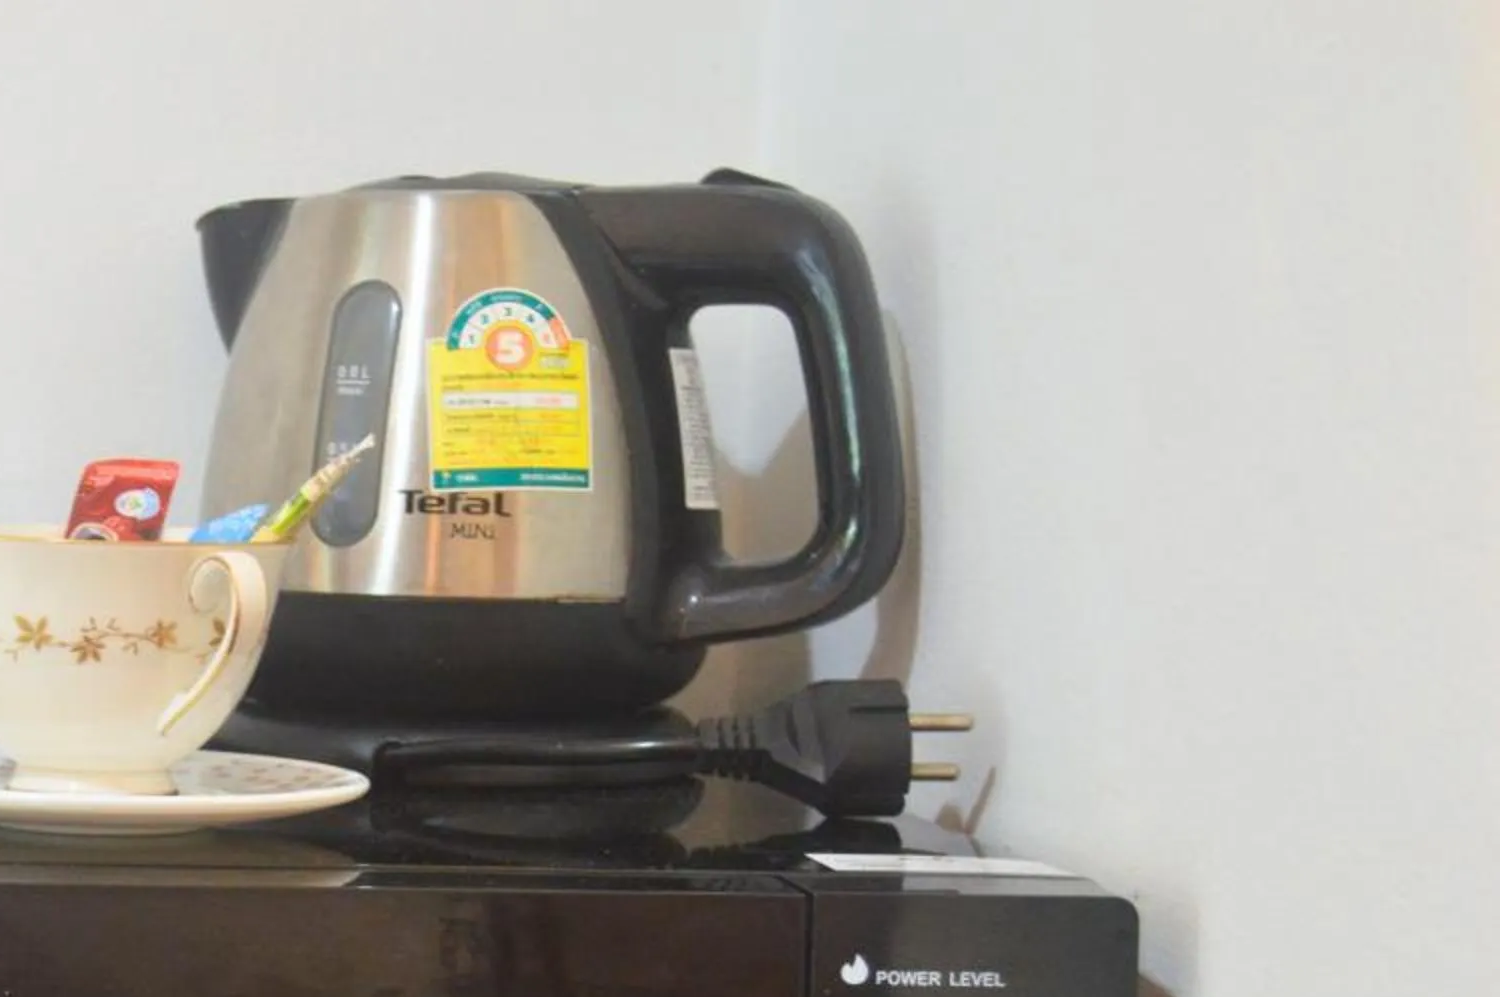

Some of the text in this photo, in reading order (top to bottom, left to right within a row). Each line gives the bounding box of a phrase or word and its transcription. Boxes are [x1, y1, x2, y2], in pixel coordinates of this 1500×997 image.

[399, 489, 513, 518] Tefal
[875, 970, 1007, 988] POWER LEVEL
